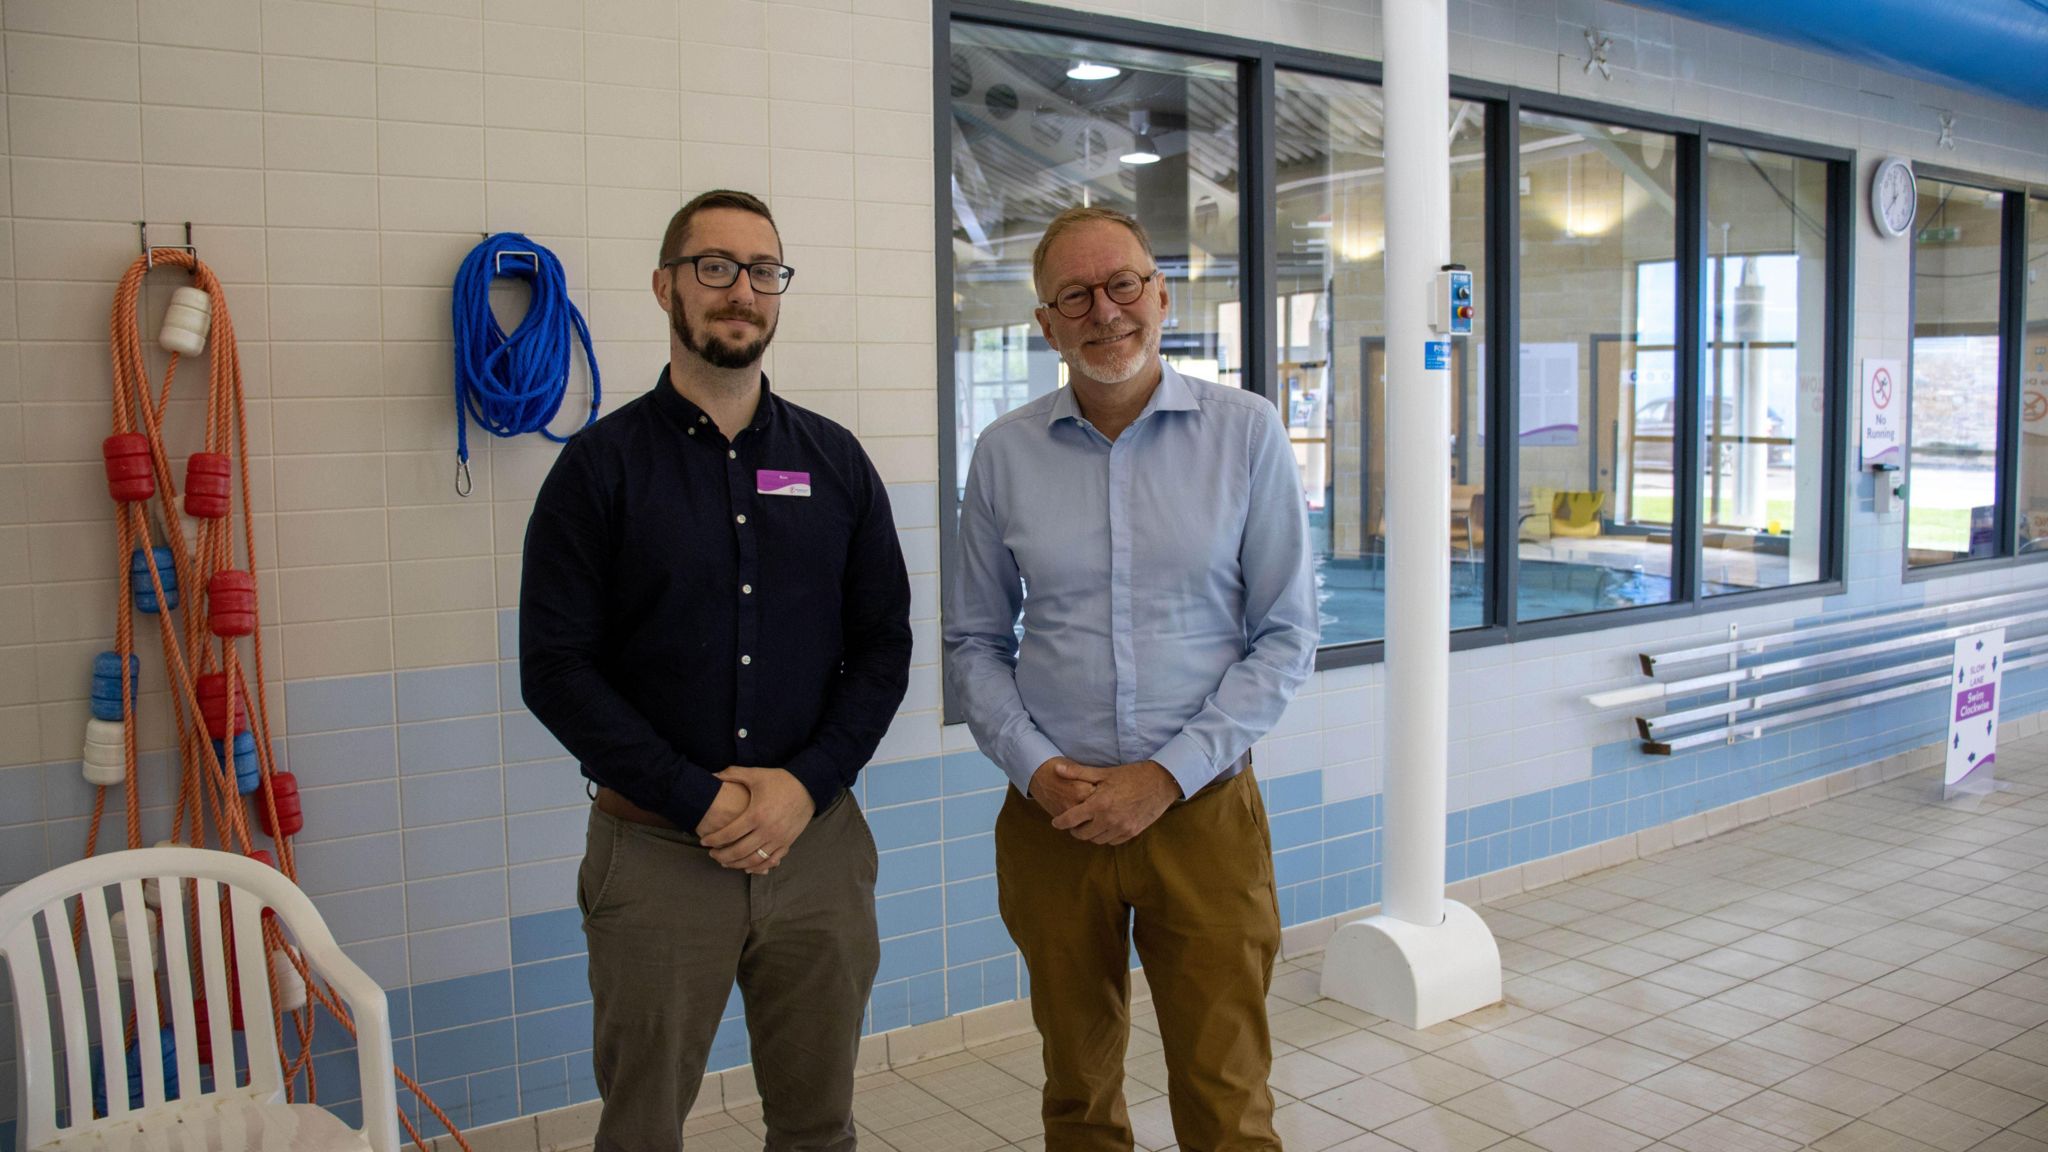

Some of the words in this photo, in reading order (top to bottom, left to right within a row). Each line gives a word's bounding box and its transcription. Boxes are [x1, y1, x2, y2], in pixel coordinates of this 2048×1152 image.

[1875, 414, 1887, 425] No
[1867, 427, 1895, 442] Running
[1970, 664, 1985, 674] SLOW
[1969, 675, 1984, 687] LANE
[1967, 691, 1985, 704] Swim
[1960, 701, 1989, 717] Clockwise
